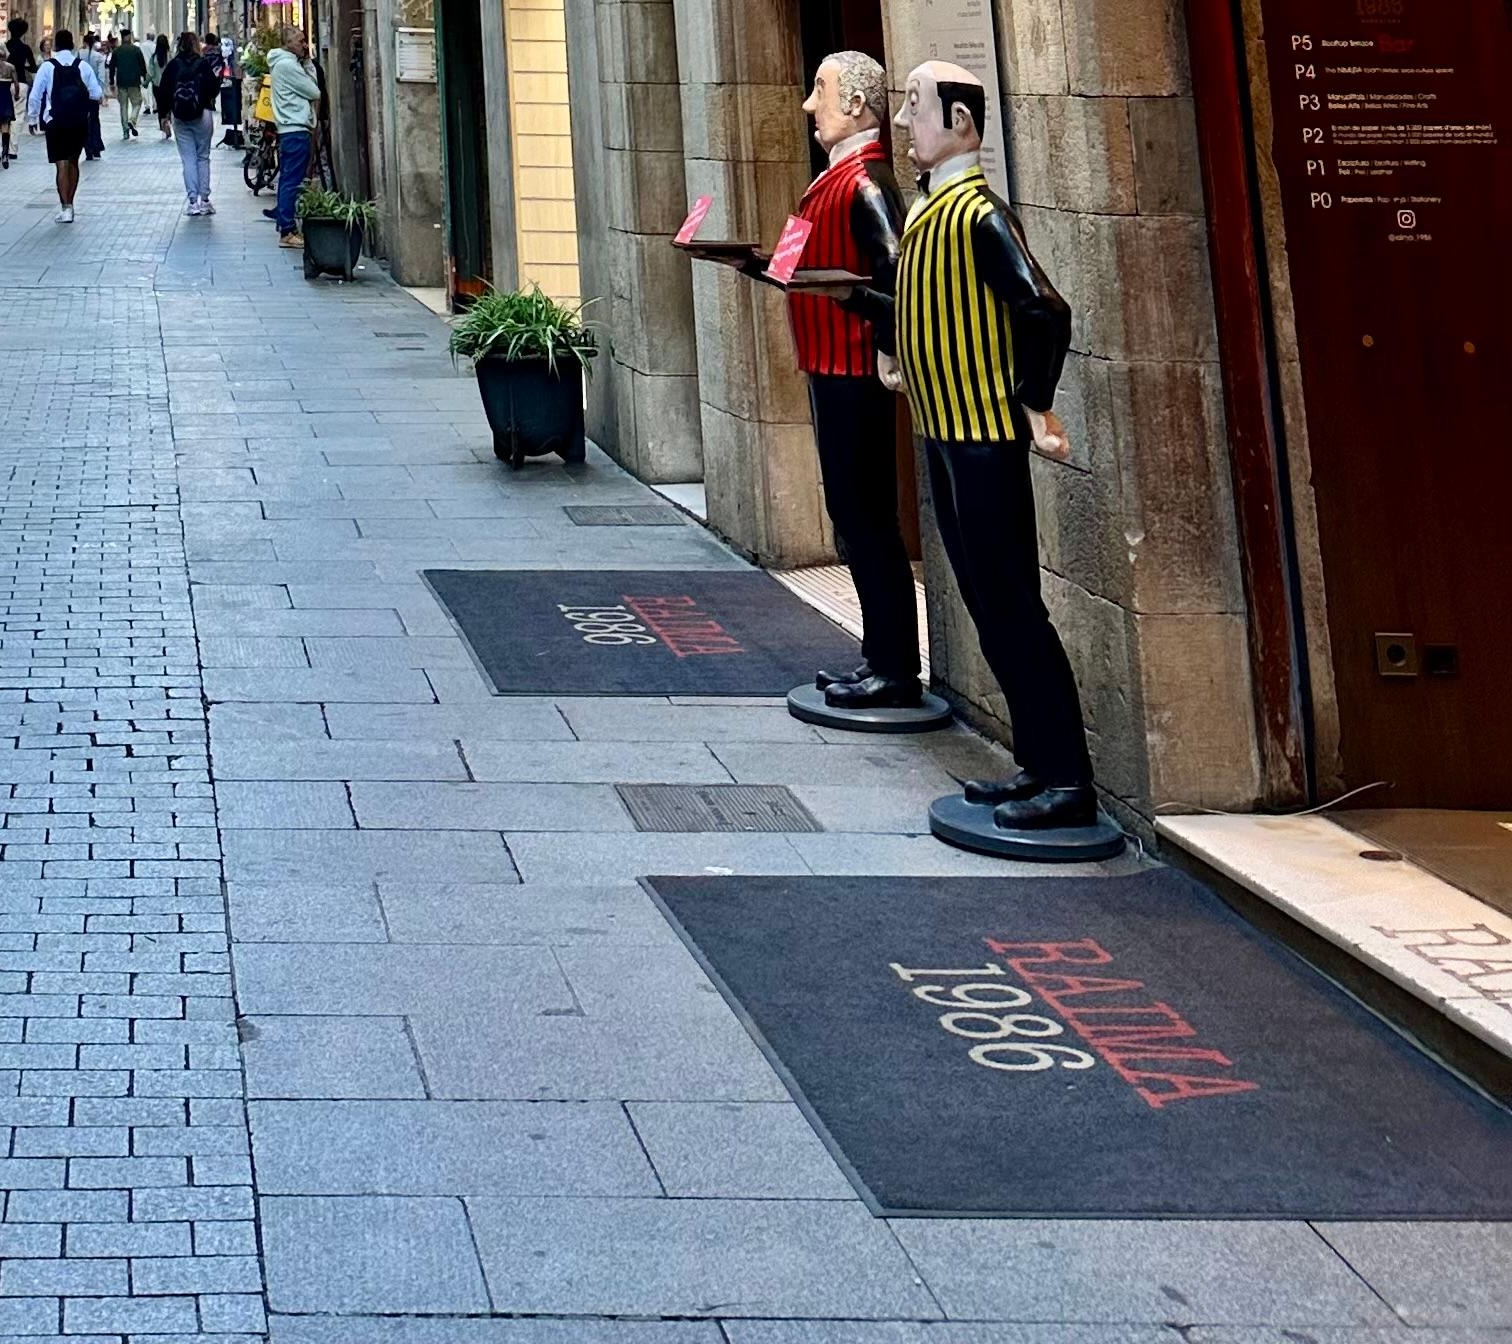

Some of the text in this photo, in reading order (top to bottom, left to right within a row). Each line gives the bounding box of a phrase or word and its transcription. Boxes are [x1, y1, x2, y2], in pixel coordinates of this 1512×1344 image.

[1292, 35, 1313, 51] P5
[1295, 64, 1316, 80] P4
[1299, 94, 1321, 110] P3
[1303, 127, 1324, 144] P2
[1306, 160, 1326, 176] P1
[1311, 192, 1332, 208] P0
[557, 603, 657, 645] 1986
[622, 594, 745, 658] RAIMA
[889, 962, 1095, 1072] 1986
[985, 936, 1259, 1110] RAIMA
